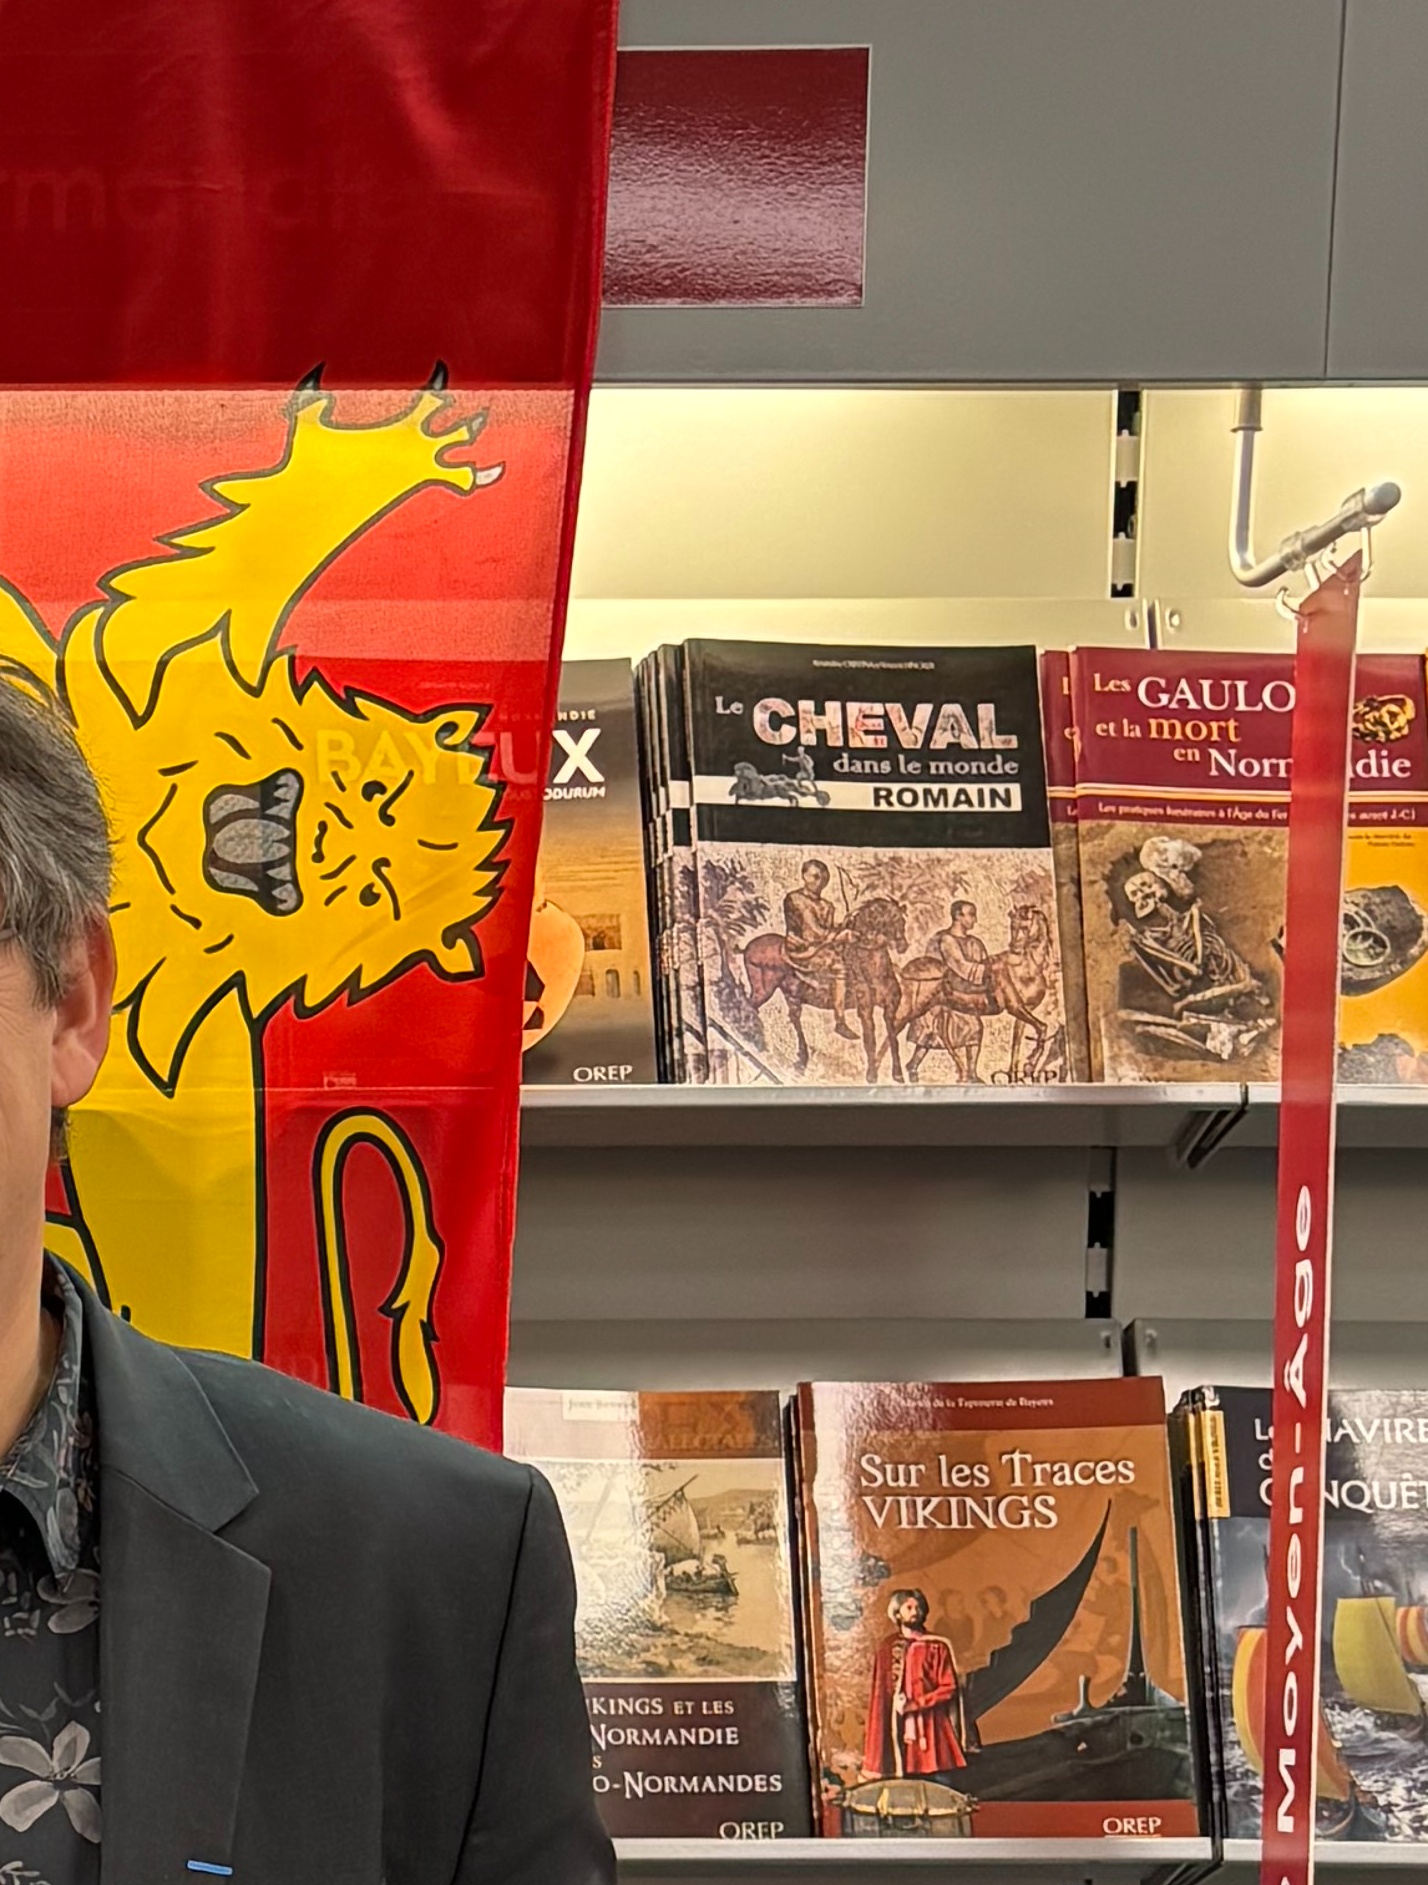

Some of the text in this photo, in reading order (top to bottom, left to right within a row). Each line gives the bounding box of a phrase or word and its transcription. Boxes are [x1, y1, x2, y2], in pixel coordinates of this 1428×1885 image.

[1094, 673, 1131, 693] Les
[715, 696, 1018, 750] Le CHEVAL
[1096, 716, 1241, 742] et la mort
[833, 753, 1020, 776] dans le monde
[1174, 748, 1200, 762] en
[873, 787, 1013, 809] ROMAIN
[573, 1065, 633, 1083] OREP
[860, 1448, 1135, 1488] Sur les Traces
[860, 1495, 1058, 1529] VIKINGS
[673, 1701, 735, 1715] ET LES
[590, 1722, 740, 1750] NORMANDIE
[719, 1821, 785, 1840] OREP
[1103, 1816, 1162, 1836] OREP
